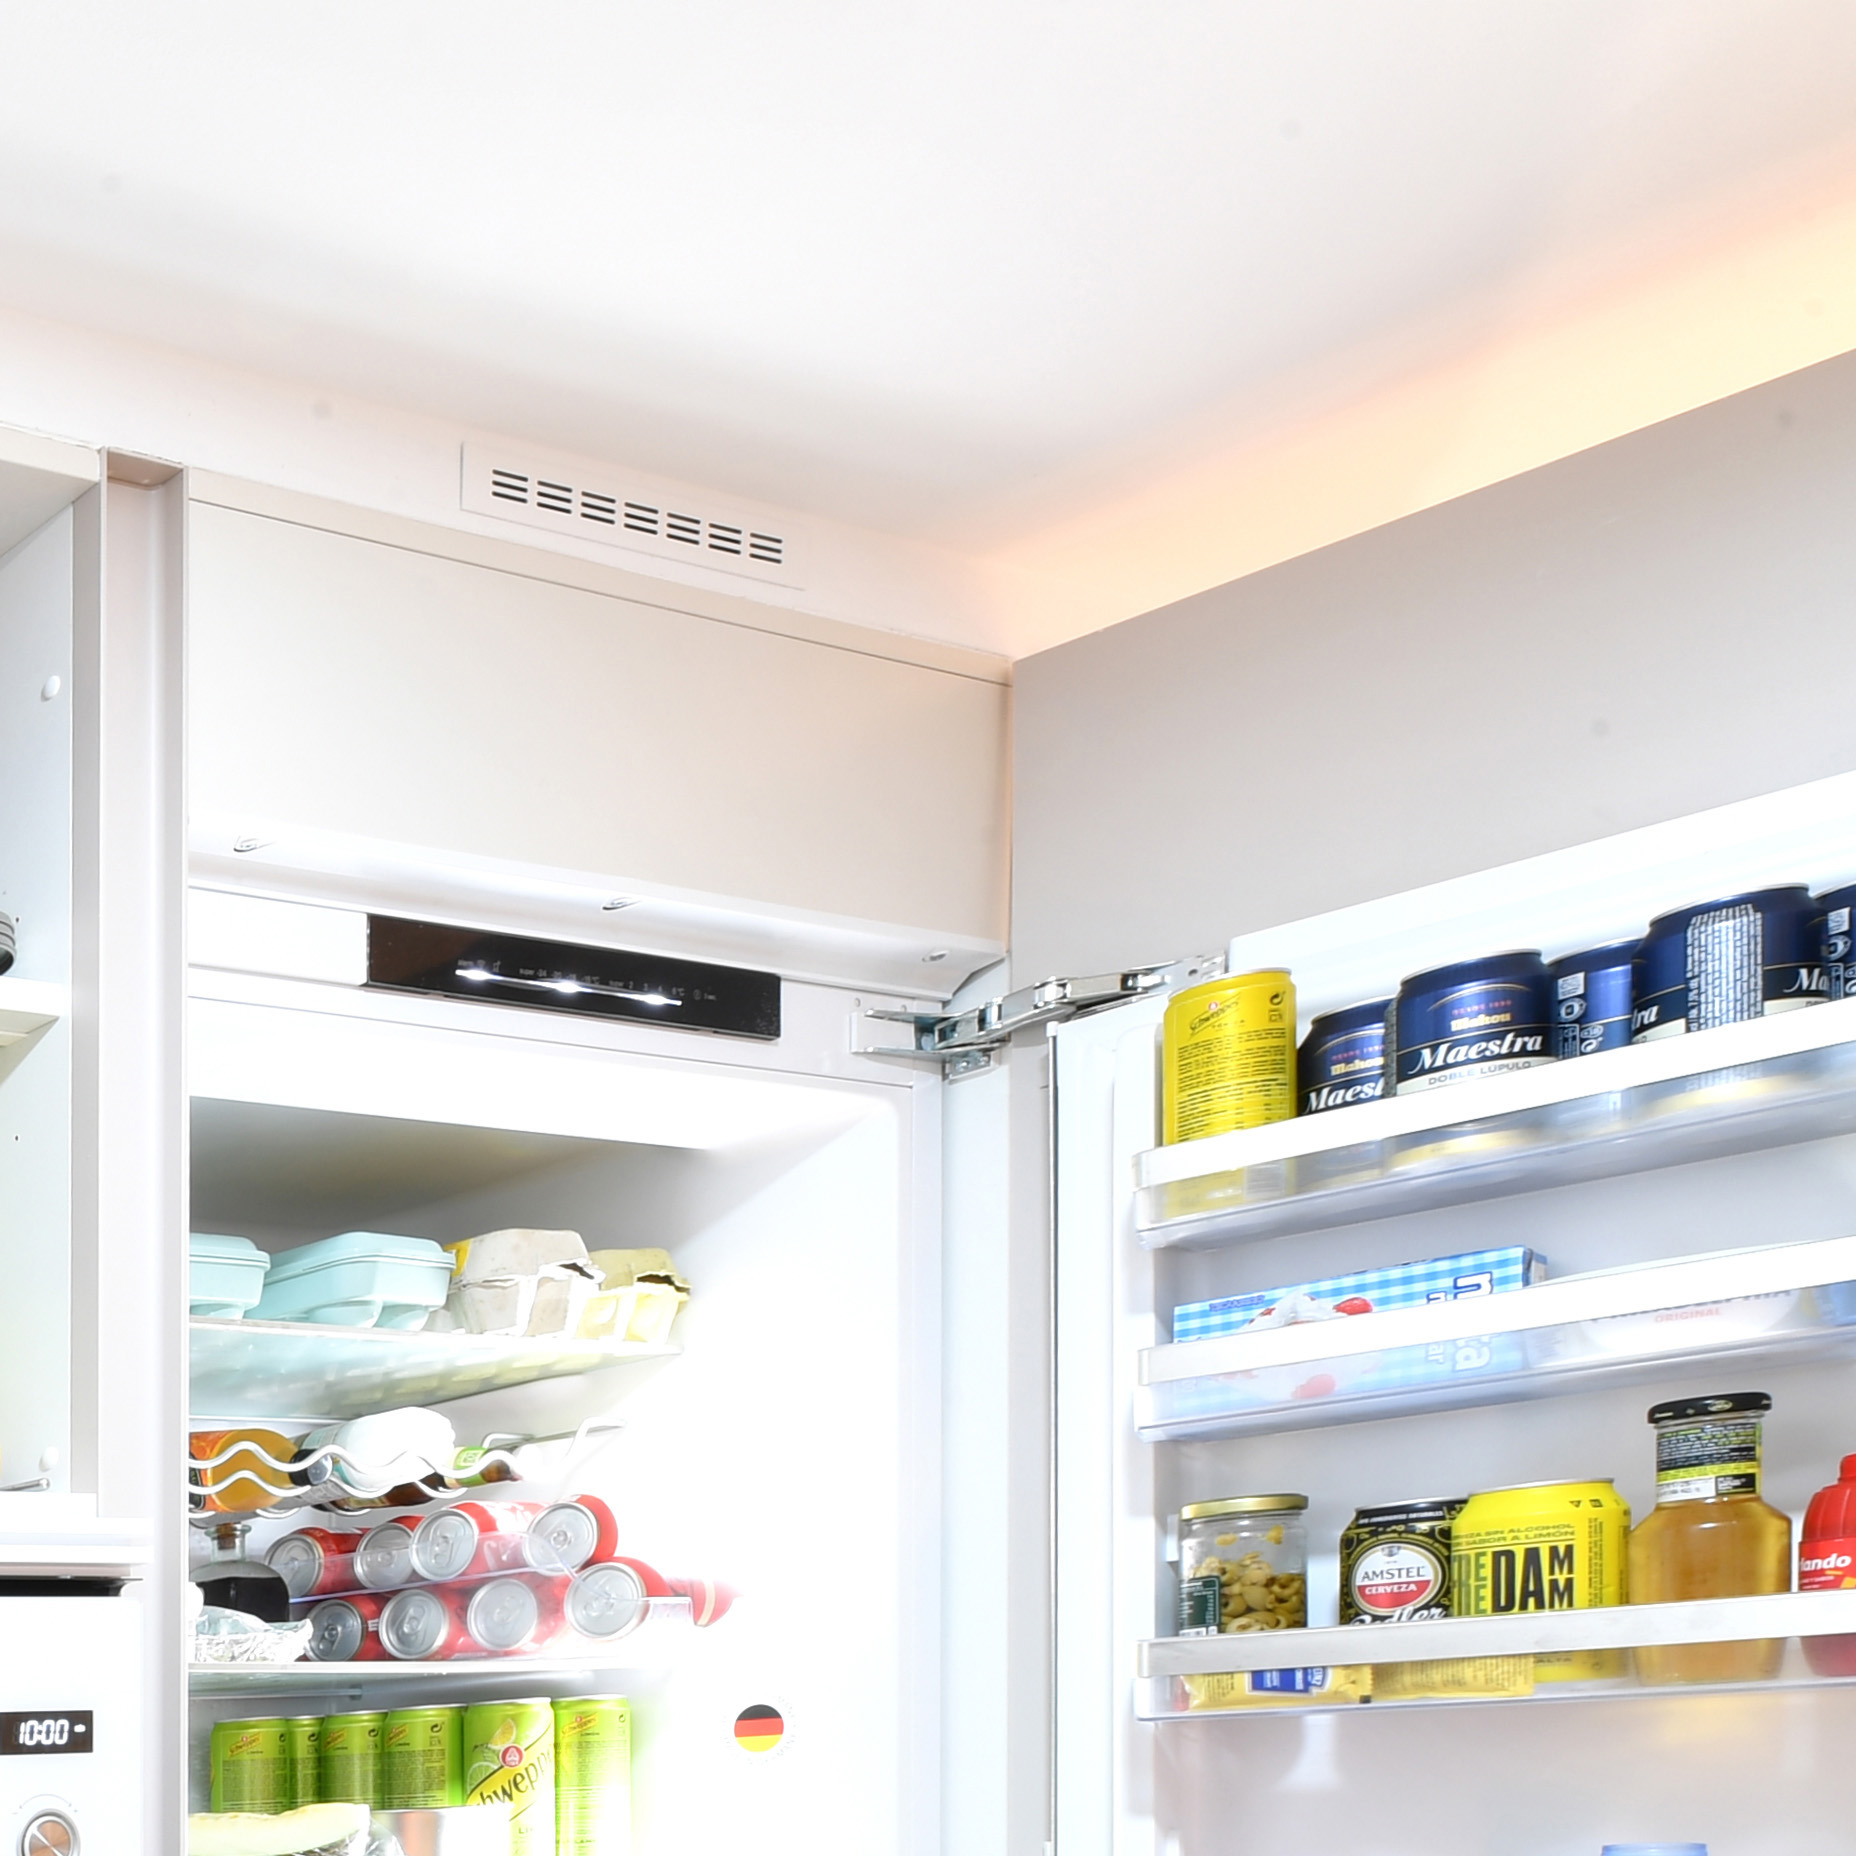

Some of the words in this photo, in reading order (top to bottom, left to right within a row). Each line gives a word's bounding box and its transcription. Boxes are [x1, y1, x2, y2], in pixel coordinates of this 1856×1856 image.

[1407, 1031, 1544, 1075] Maestra
[1428, 1067, 1477, 1086] DOBLE
[1653, 1306, 1723, 1324] ORIGINAL
[1507, 1522, 1576, 1534] ALCOHOL
[1510, 1534, 1521, 1542] A
[1524, 1529, 1576, 1540] LIMÓN
[1360, 1565, 1427, 1582] AMSTEL
[1491, 1544, 1575, 1614] DAMM
[1364, 1582, 1419, 1596] CERVEZA
[19, 1719, 70, 1746] 10:00
